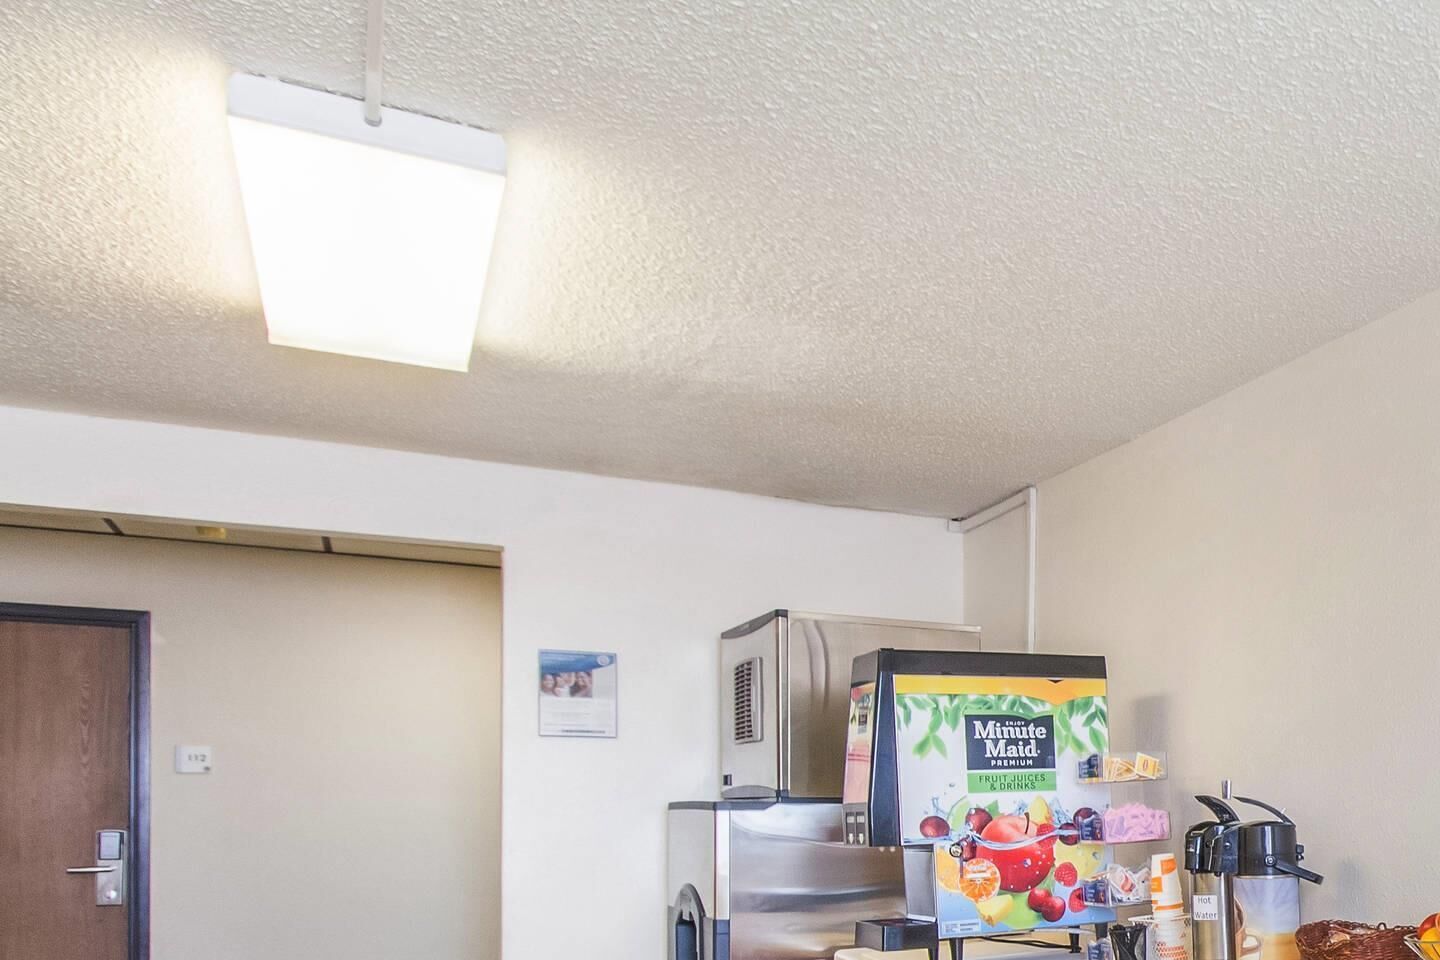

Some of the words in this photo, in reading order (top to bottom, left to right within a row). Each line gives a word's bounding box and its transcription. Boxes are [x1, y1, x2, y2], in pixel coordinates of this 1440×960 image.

[972, 720, 1047, 739] Minute
[983, 739, 1038, 758] Maid
[990, 759, 1033, 767] PREMIUM
[979, 774, 1008, 783] FRUIT
[1010, 773, 1046, 782] JUICES
[989, 783, 997, 791] &
[999, 781, 1036, 791] DRINKS
[1197, 896, 1211, 904] Hot
